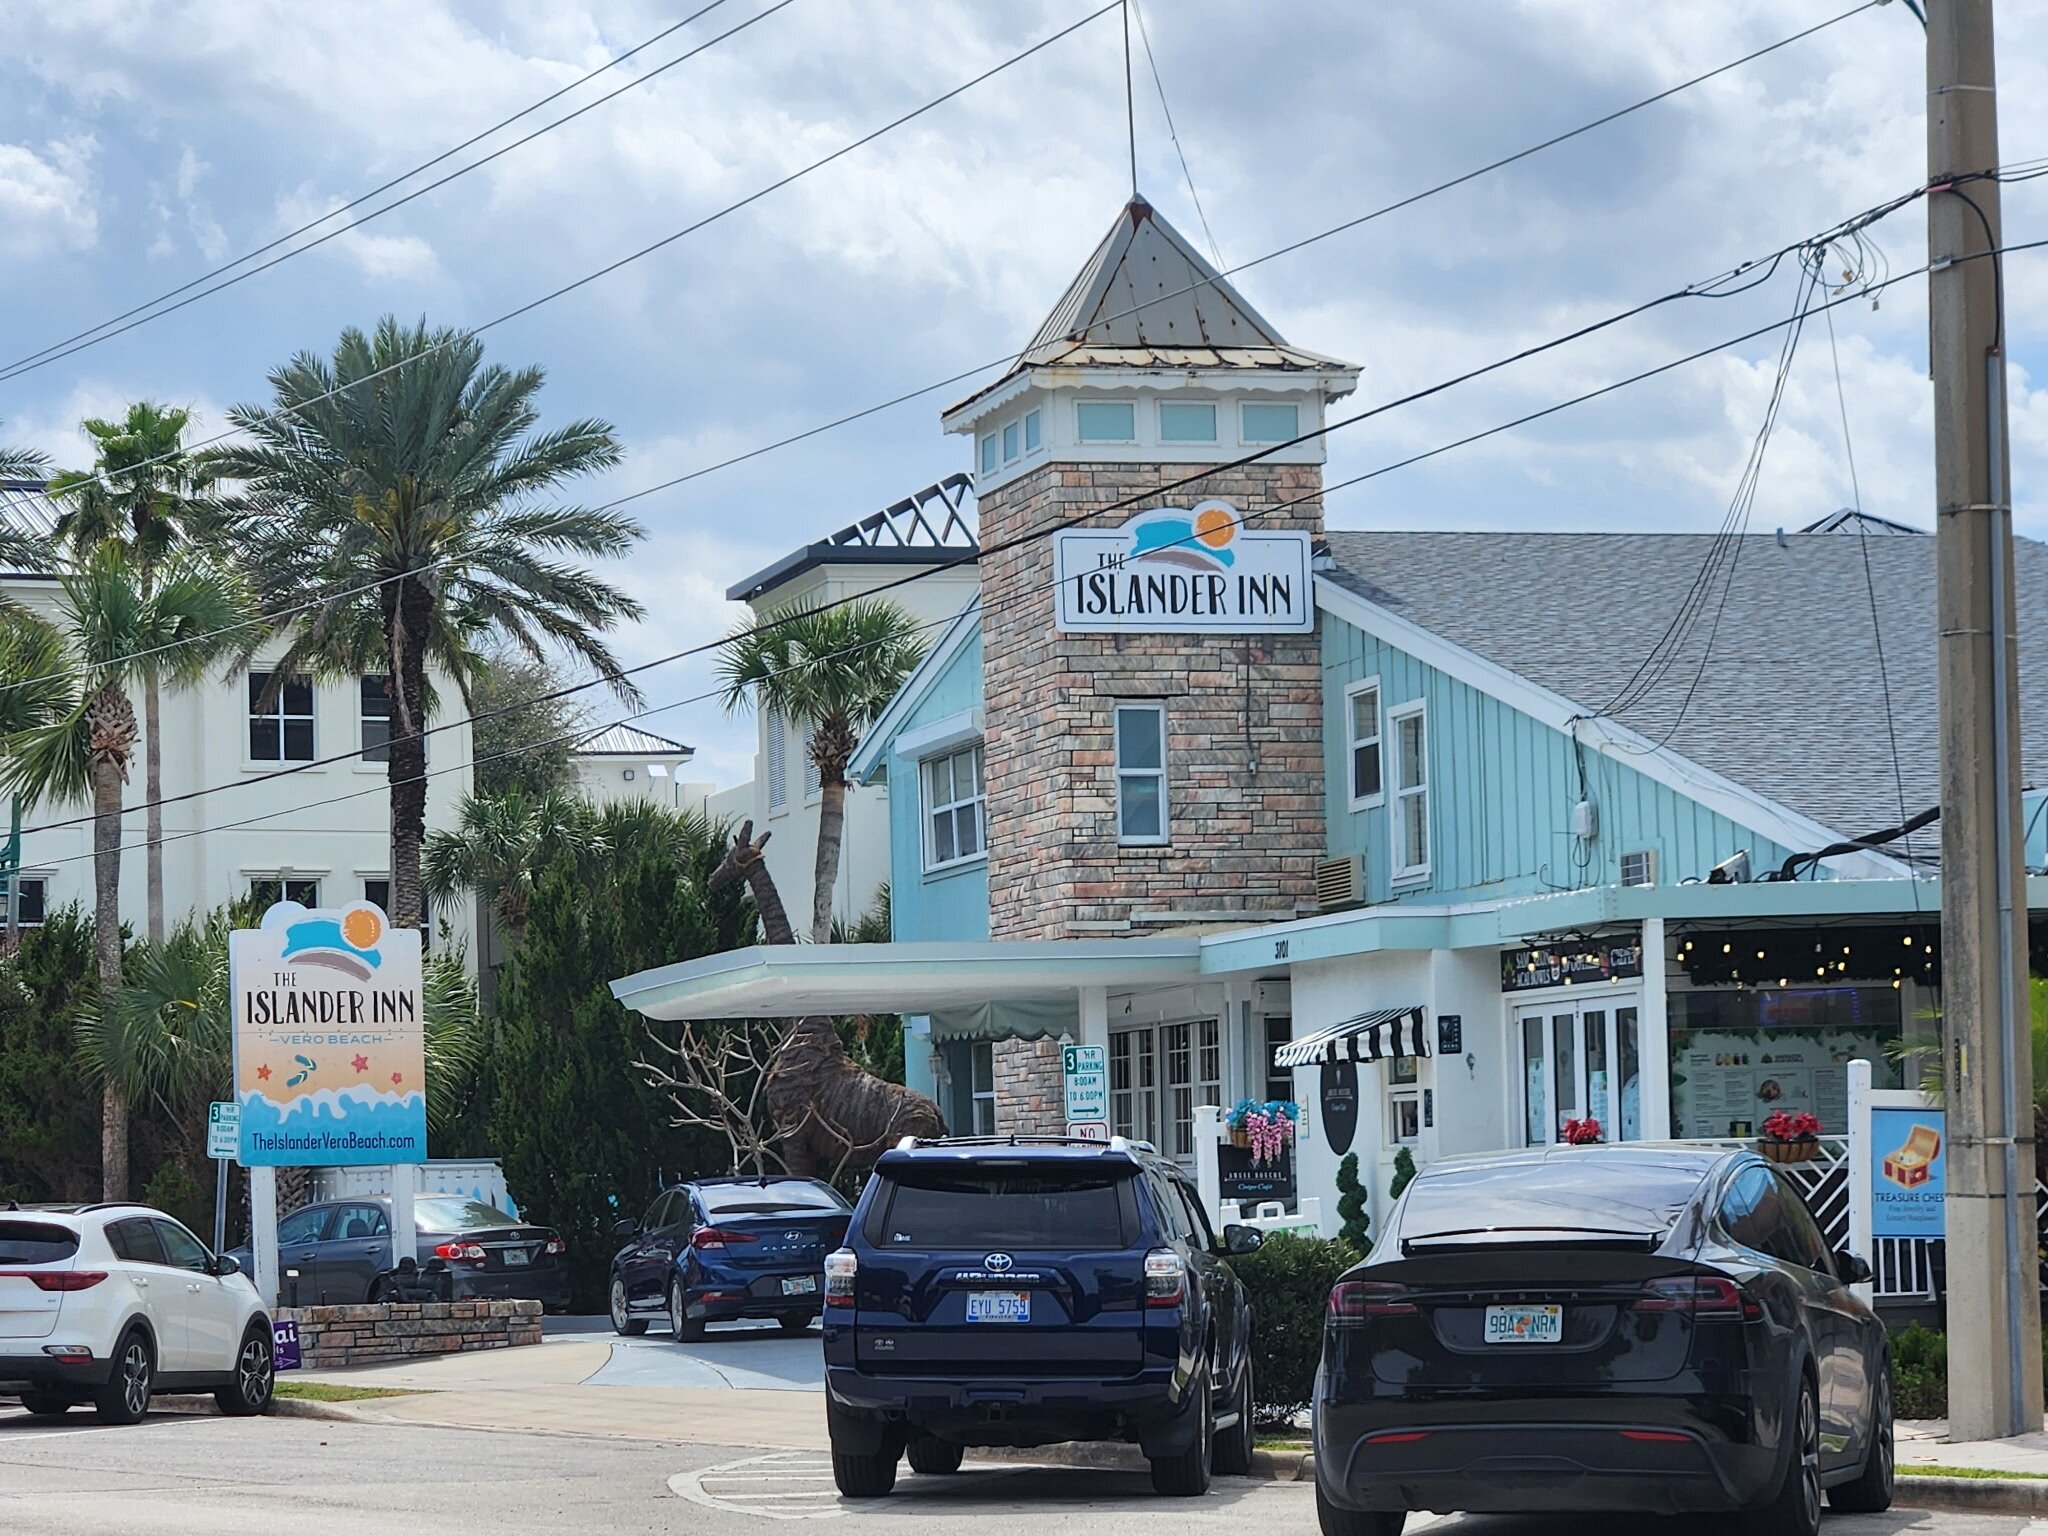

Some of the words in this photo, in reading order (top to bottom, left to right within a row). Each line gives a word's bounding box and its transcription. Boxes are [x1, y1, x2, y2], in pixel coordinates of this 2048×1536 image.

[1097, 553, 1125, 570] THE
[1077, 573, 1226, 615] ISLANDER
[1239, 574, 1291, 615] INN
[274, 972, 297, 987] THE
[247, 991, 364, 1024] ISLANDER
[373, 990, 414, 1023] INN
[280, 1035, 324, 1044] VERO
[328, 1034, 383, 1044] BEACH
[1066, 1053, 1075, 1071] 3
[1078, 1061, 1103, 1071] PARKING
[1069, 1092, 1077, 1101] TO
[212, 1106, 219, 1120] 3
[252, 1130, 415, 1150] TheIslanderVeroBeach.com
[1874, 1193, 1920, 1202] TREASURE
[1922, 1193, 1945, 1202] CHES
[971, 1300, 991, 1314] EYU
[999, 1299, 1026, 1314] 5759
[274, 1323, 297, 1344] ai
